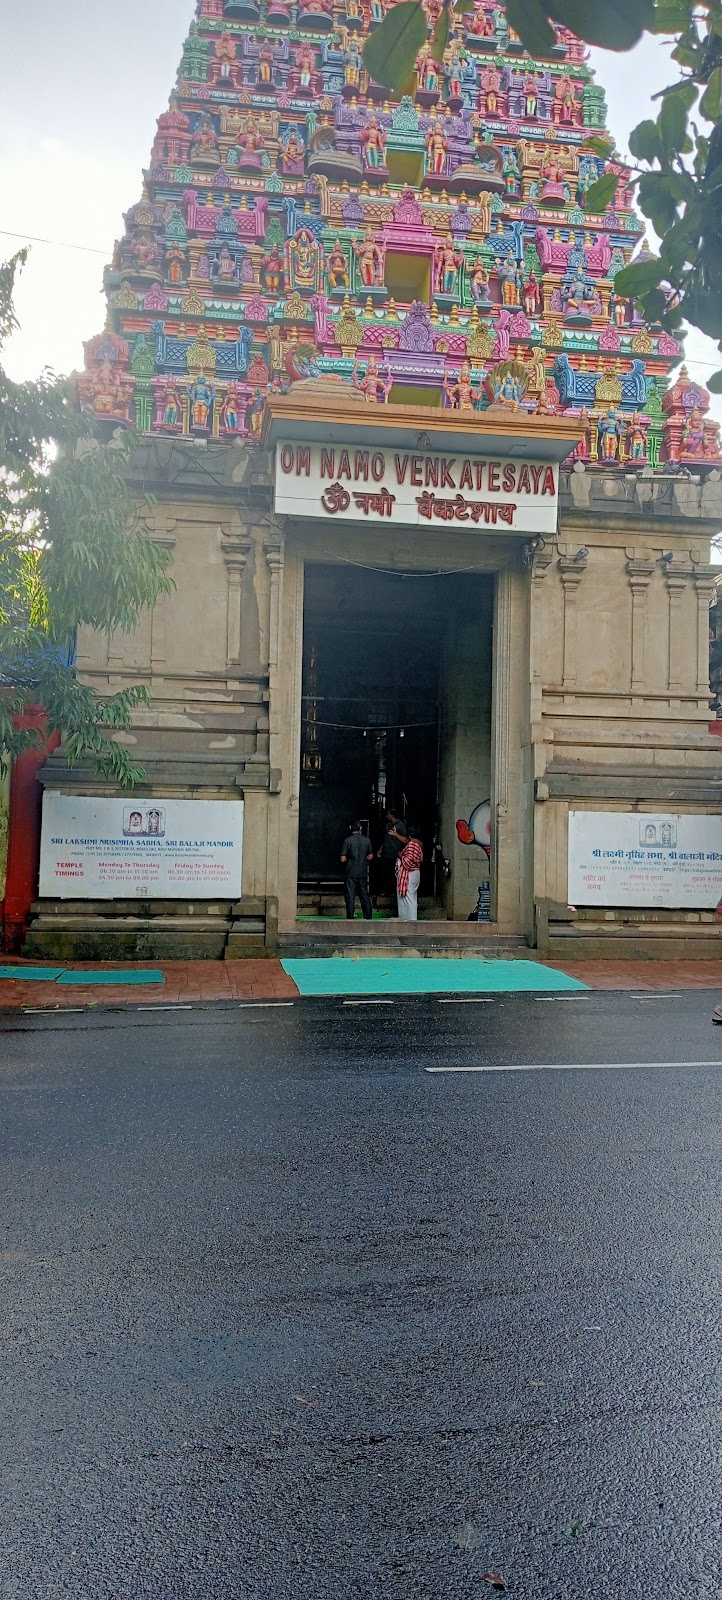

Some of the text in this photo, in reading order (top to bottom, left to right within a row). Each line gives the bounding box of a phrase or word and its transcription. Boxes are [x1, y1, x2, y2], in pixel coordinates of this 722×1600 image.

[280, 443, 311, 477] OM
[320, 448, 386, 482] NAMO
[321, 482, 350, 514] ॐ
[352, 487, 396, 517] नमो
